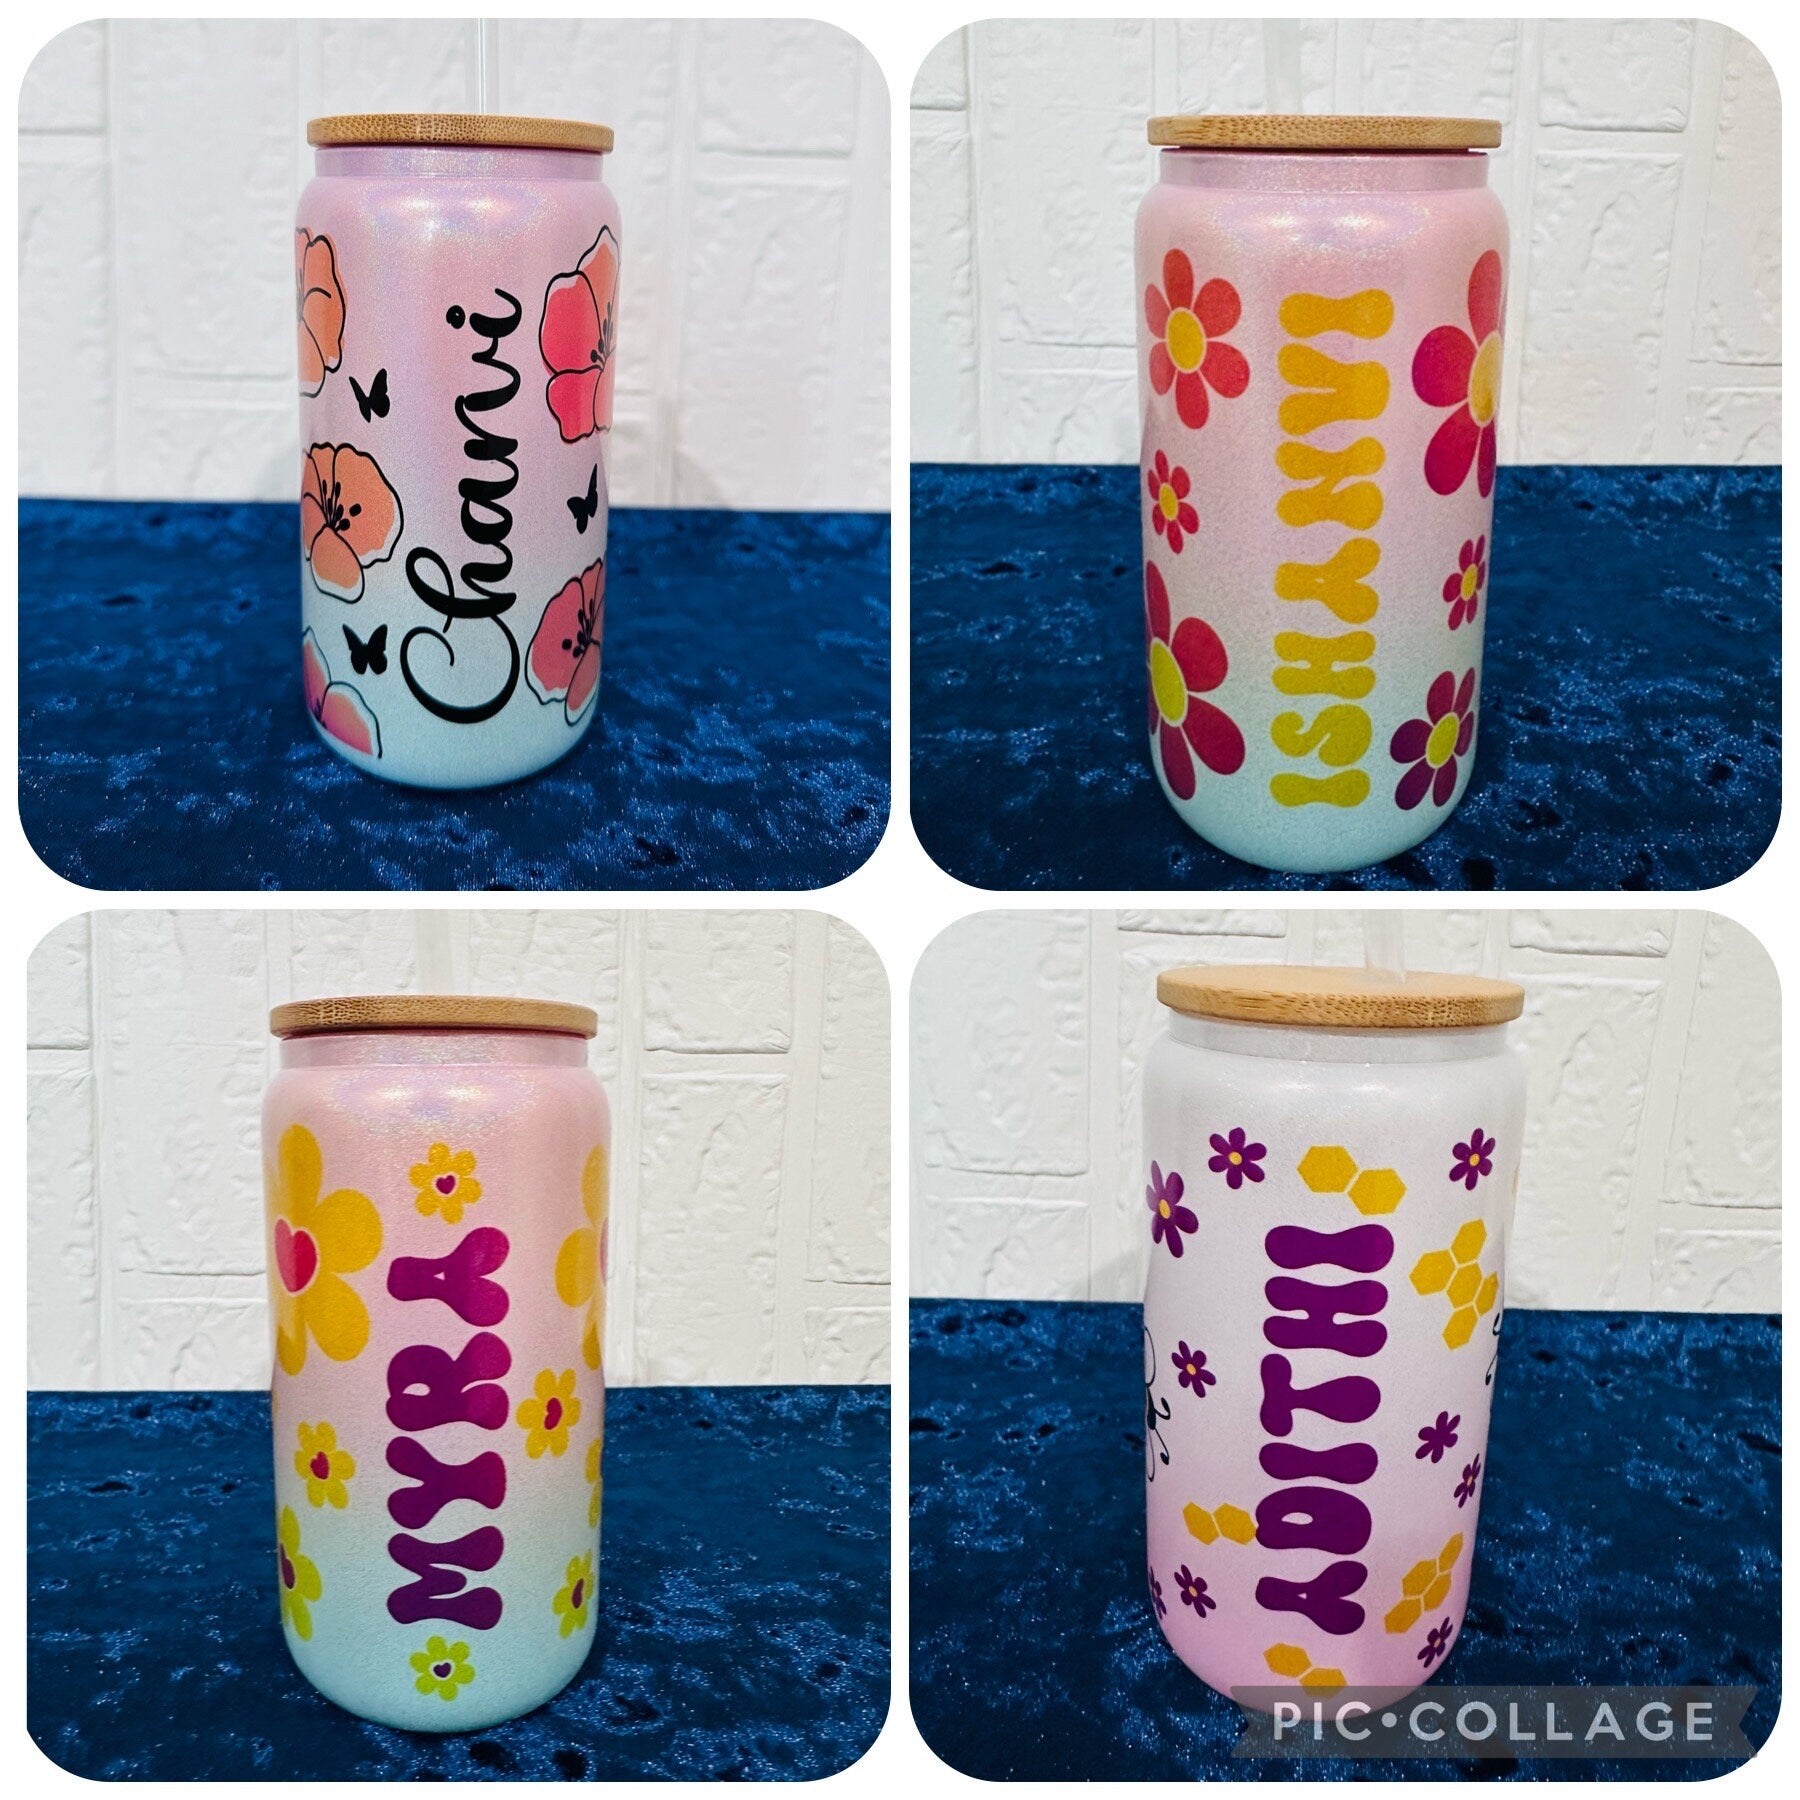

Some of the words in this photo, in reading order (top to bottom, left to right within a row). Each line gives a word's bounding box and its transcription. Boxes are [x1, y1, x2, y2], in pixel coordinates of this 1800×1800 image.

[400, 288, 523, 724] Charvi
[1270, 288, 1394, 808] ISHANVI
[387, 1227, 511, 1630] MYRA
[1255, 1224, 1394, 1634] ADITHI
